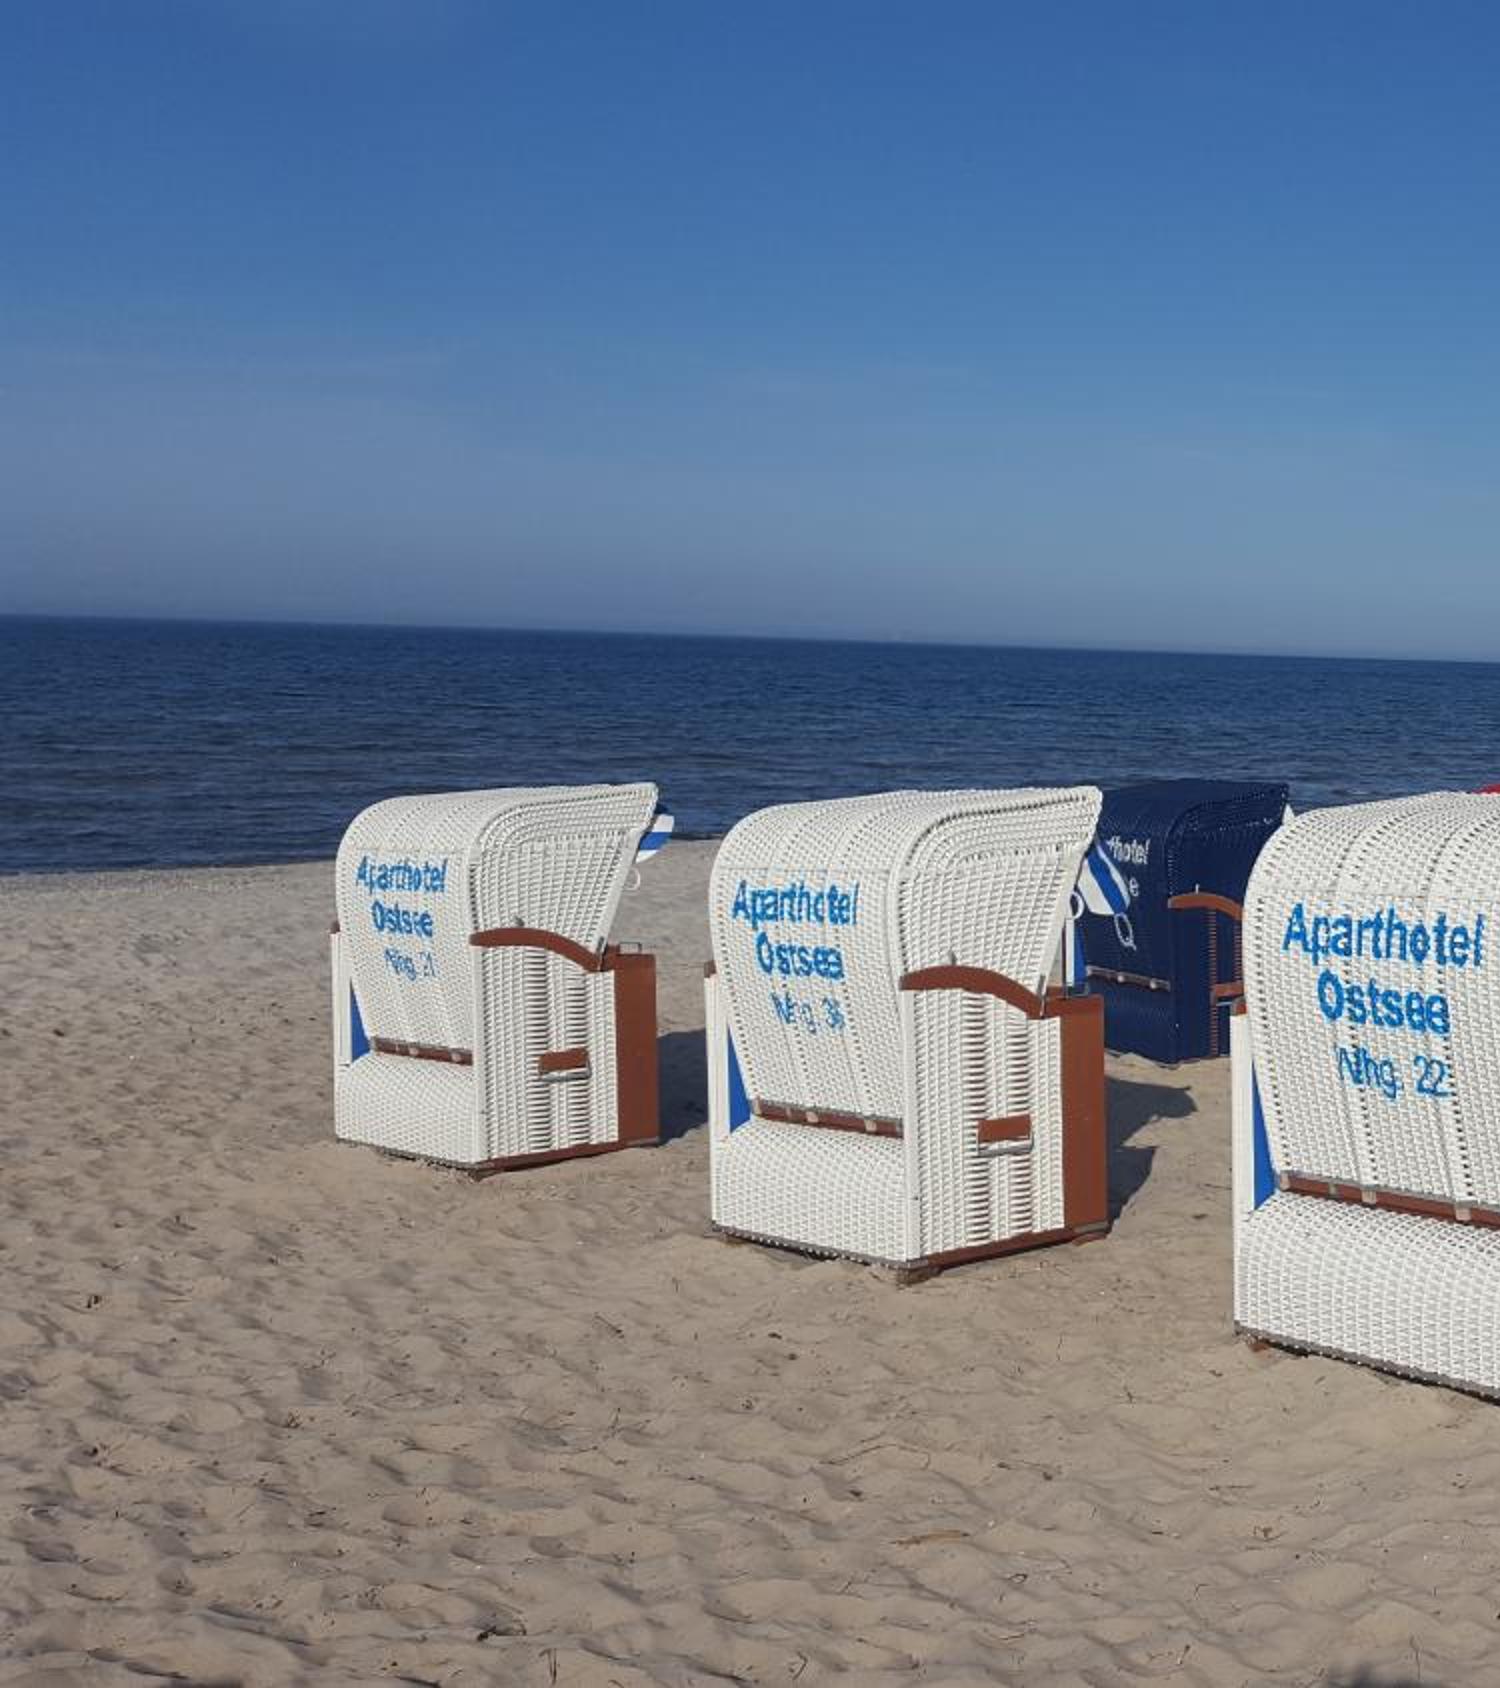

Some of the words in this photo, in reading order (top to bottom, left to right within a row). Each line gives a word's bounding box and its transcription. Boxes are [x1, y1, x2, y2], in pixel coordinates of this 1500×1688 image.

[355, 855, 448, 895] Aparthotel
[371, 900, 433, 938] Ostsee
[731, 880, 860, 931] Aparthotel
[756, 931, 845, 980] Ostsee
[1281, 902, 1486, 967] Aparthotel
[1316, 967, 1451, 1035] Ostsee
[1414, 1055, 1451, 1097] 22
